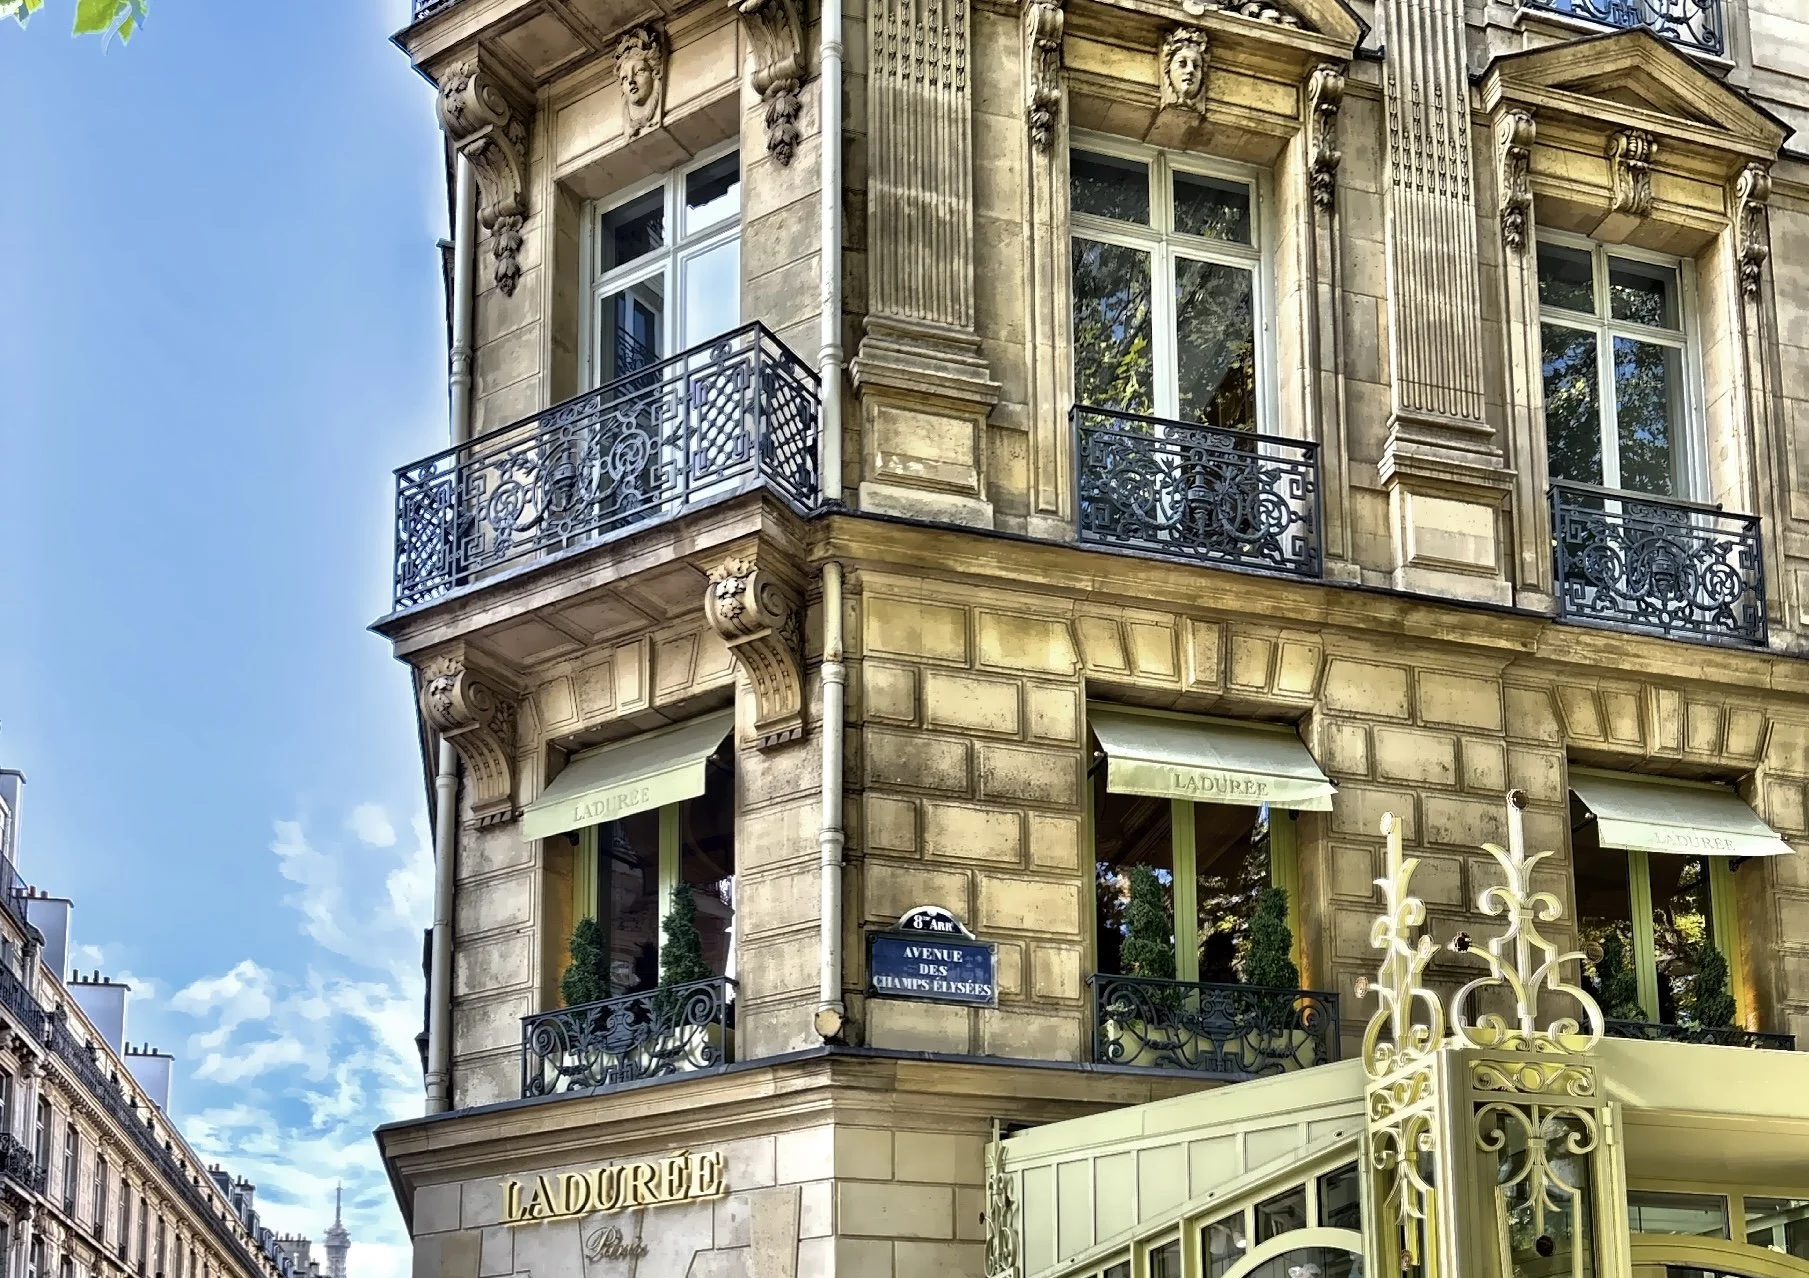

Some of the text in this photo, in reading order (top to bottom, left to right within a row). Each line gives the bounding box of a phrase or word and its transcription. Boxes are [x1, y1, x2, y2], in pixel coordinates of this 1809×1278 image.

[903, 946, 963, 963] AVENUE
[919, 963, 948, 977] DES
[872, 975, 992, 997] CHAMPS ÉLYSÉES
[500, 1149, 726, 1224] LADURÉE
[584, 1225, 649, 1264] Paris
